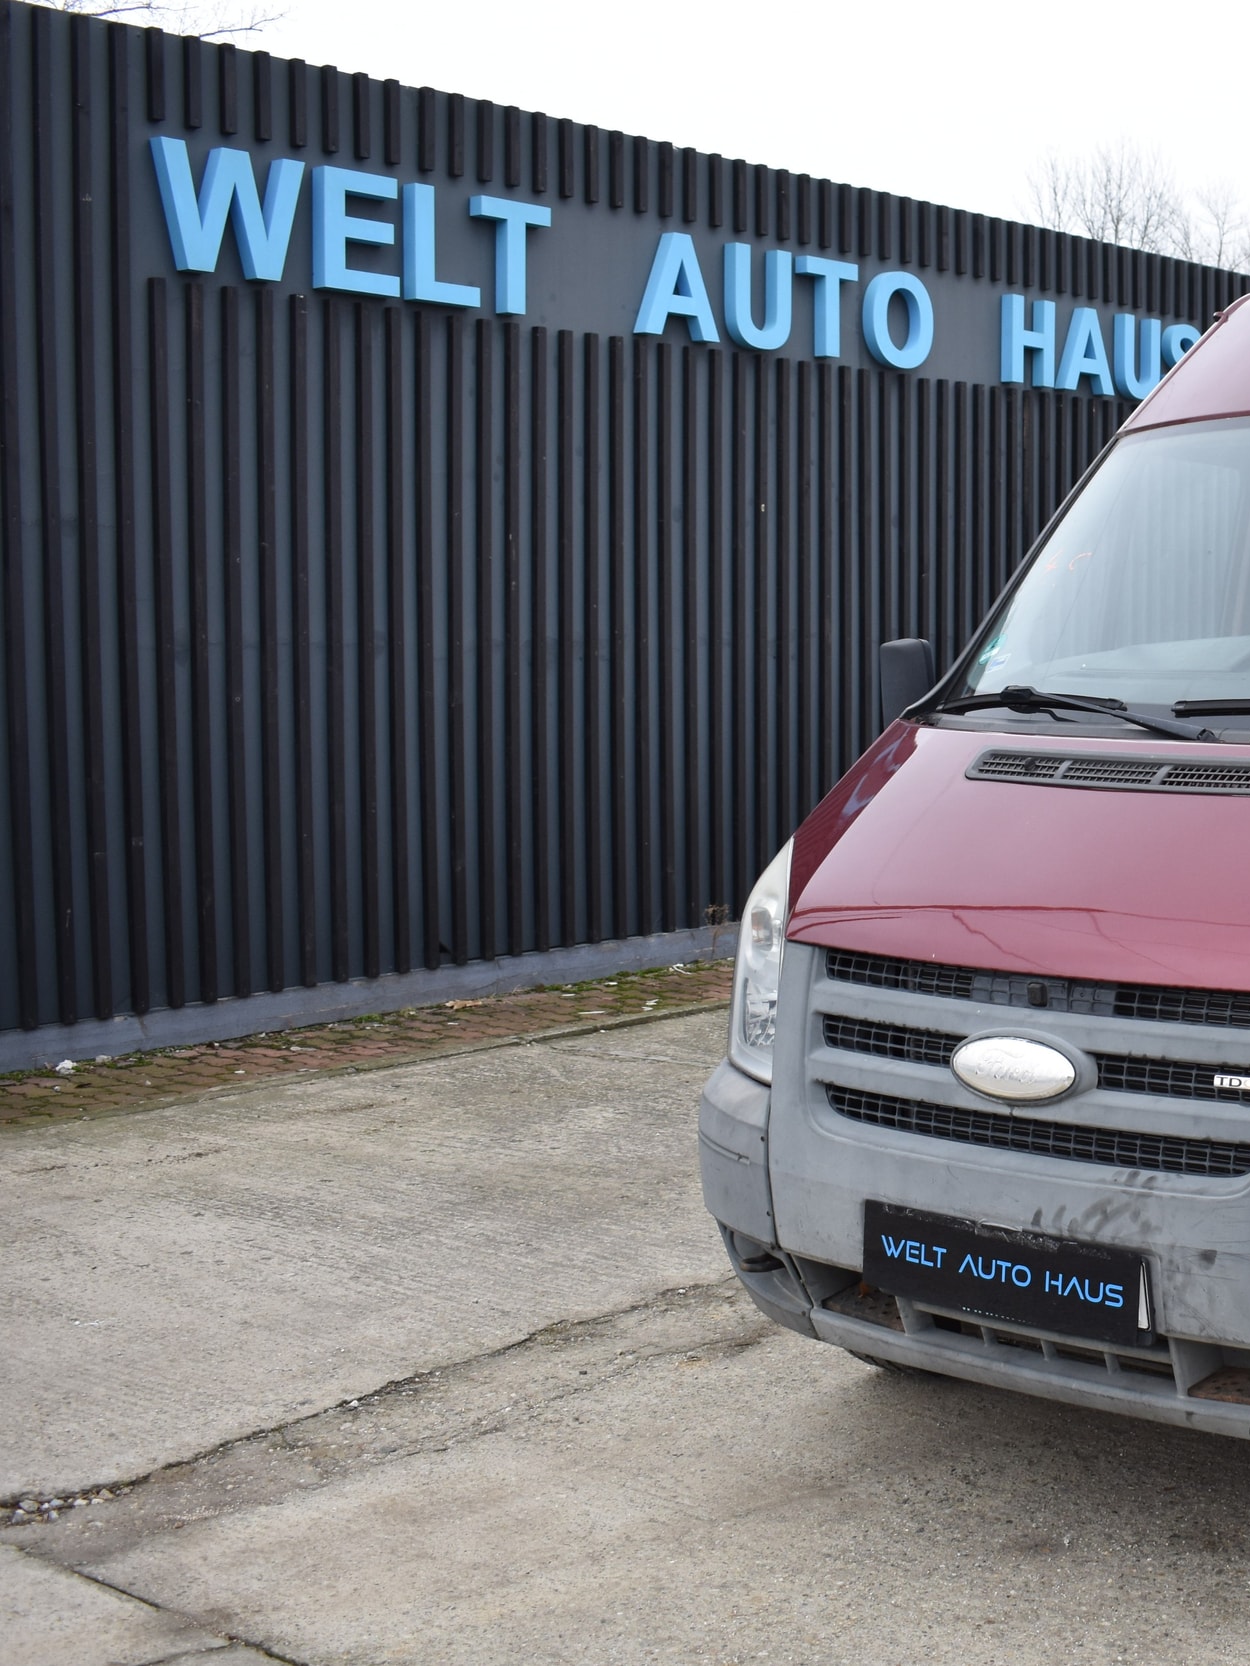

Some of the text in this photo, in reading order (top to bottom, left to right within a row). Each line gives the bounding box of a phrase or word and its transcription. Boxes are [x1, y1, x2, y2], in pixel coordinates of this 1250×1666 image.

[150, 136, 552, 315] WELT
[633, 231, 934, 369] AUTO
[880, 1234, 1124, 1308] WELT AUTO HAUS
